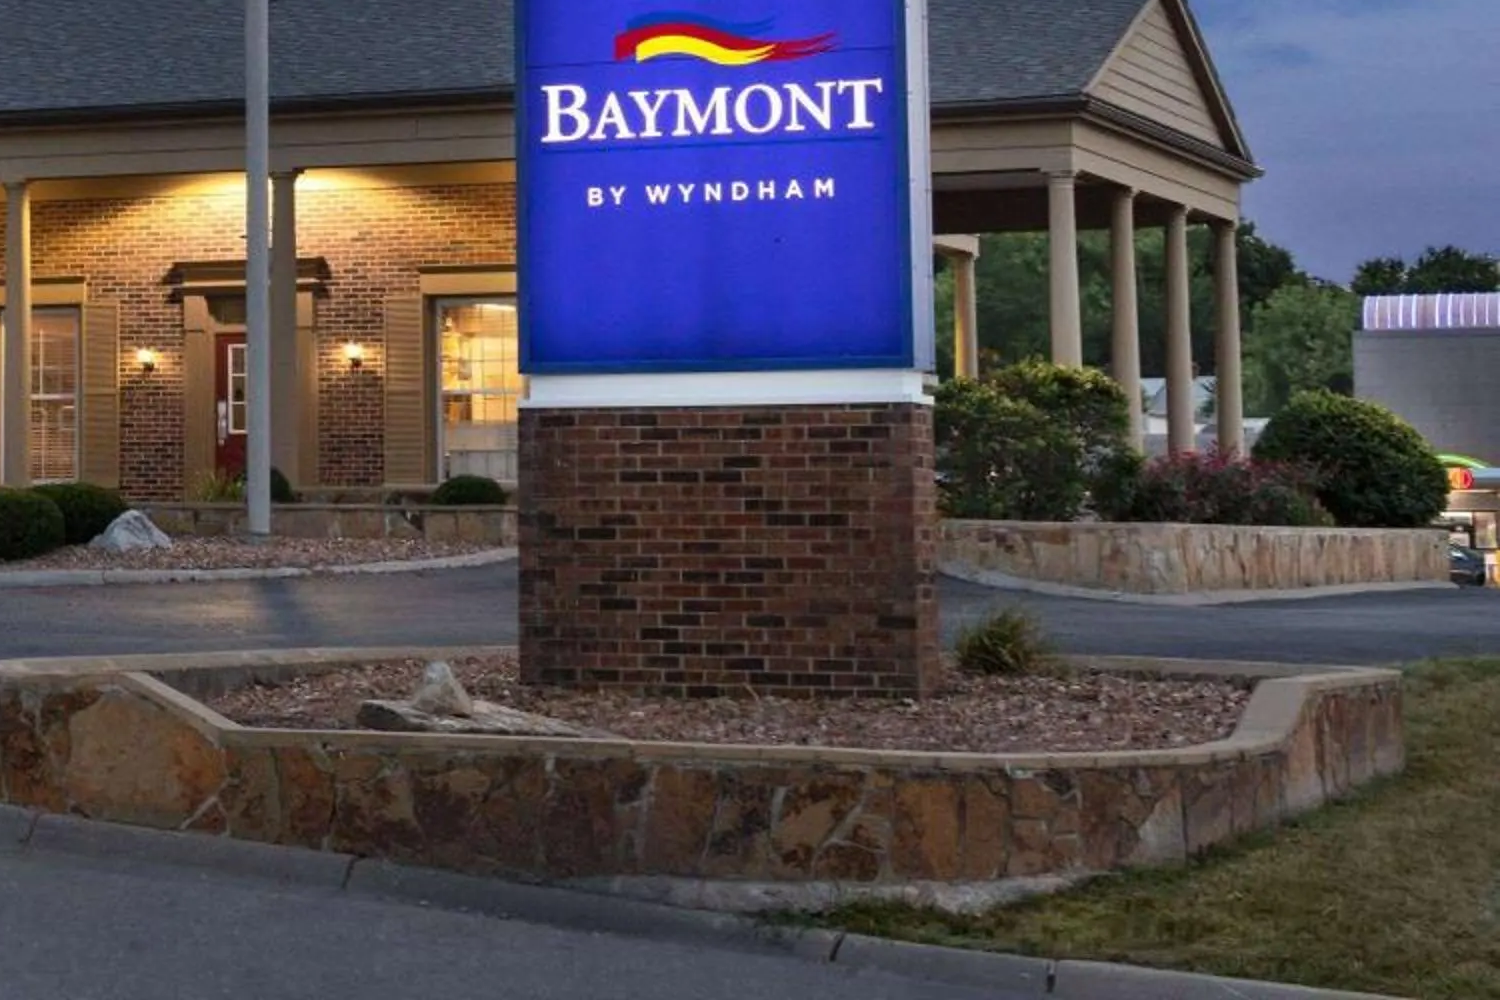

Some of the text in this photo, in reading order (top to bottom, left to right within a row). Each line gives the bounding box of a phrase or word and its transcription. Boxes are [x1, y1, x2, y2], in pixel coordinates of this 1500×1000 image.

[540, 77, 883, 143] BAYMONT
[587, 178, 835, 207] BY WYNDHAM
